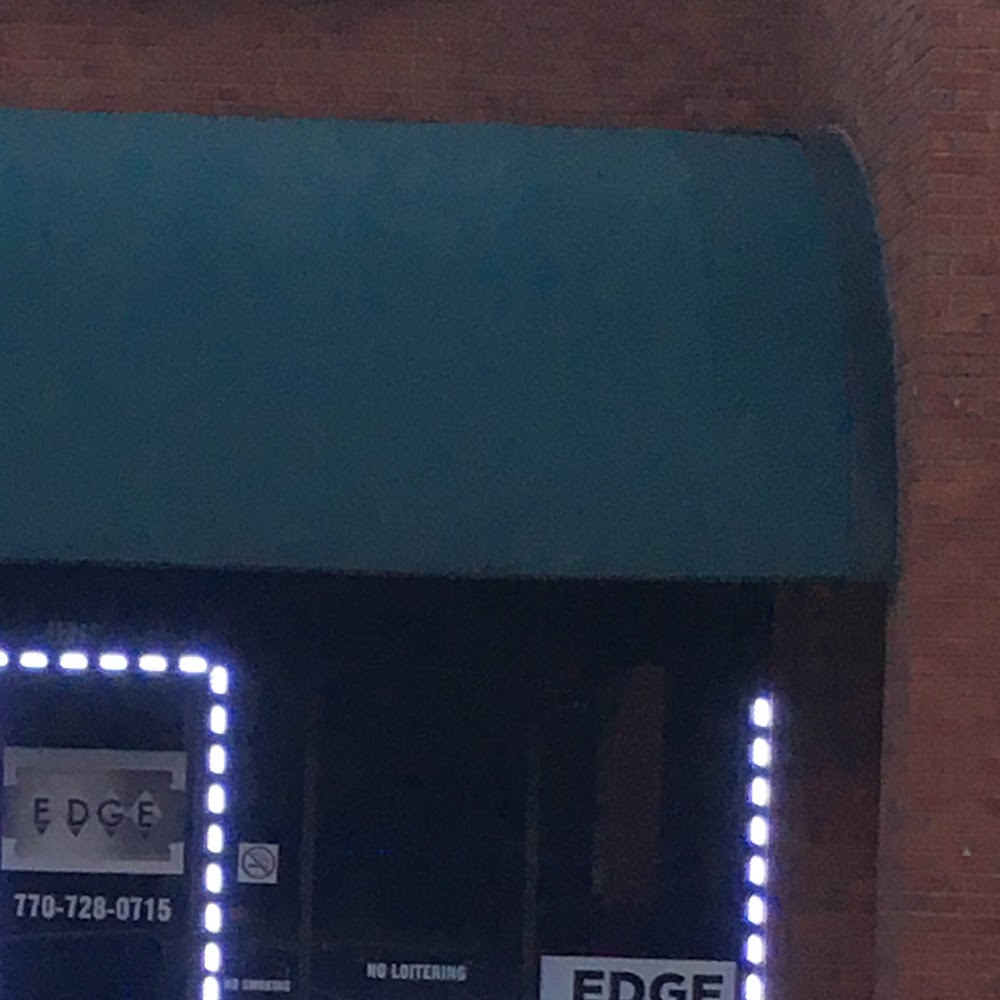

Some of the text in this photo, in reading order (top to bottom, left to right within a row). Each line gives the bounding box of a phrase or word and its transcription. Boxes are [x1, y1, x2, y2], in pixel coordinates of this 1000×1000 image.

[33, 797, 154, 828] EDGE
[14, 893, 172, 922] 770-728-0715
[366, 962, 468, 983] NO LOITERING
